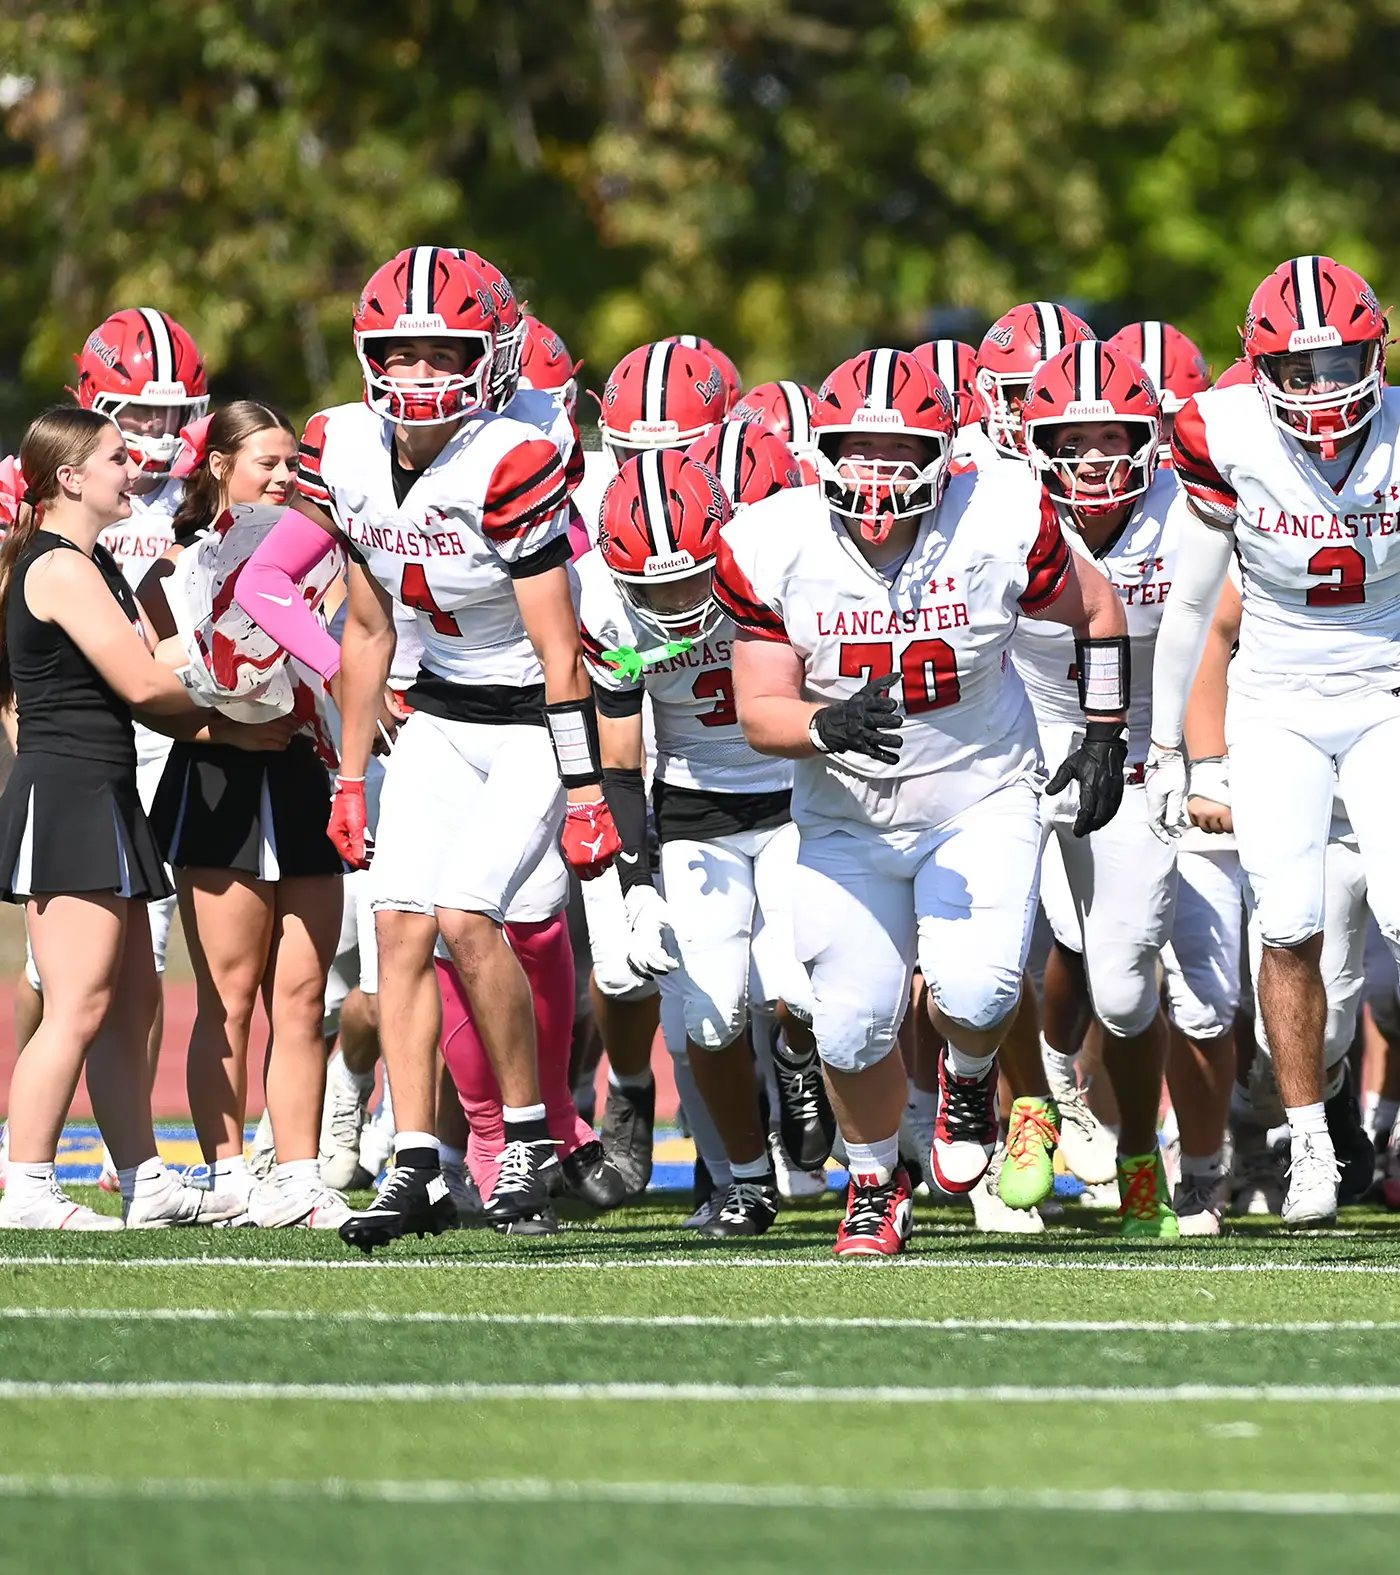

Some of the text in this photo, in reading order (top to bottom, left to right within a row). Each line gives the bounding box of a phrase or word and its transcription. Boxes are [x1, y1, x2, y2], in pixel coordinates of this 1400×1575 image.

[400, 319, 441, 329] Riddell
[1293, 332, 1336, 345] Riddell
[857, 413, 899, 424] Riddell
[1069, 405, 1110, 415] Riddell
[104, 535, 174, 558] NCAST
[346, 517, 466, 558] LANCASTER
[648, 556, 689, 571] Riddell
[1305, 545, 1367, 607] 2
[400, 561, 464, 638] 4
[816, 602, 970, 636] LANCASTER
[641, 640, 734, 675] ANCAS
[838, 637, 962, 716] 70
